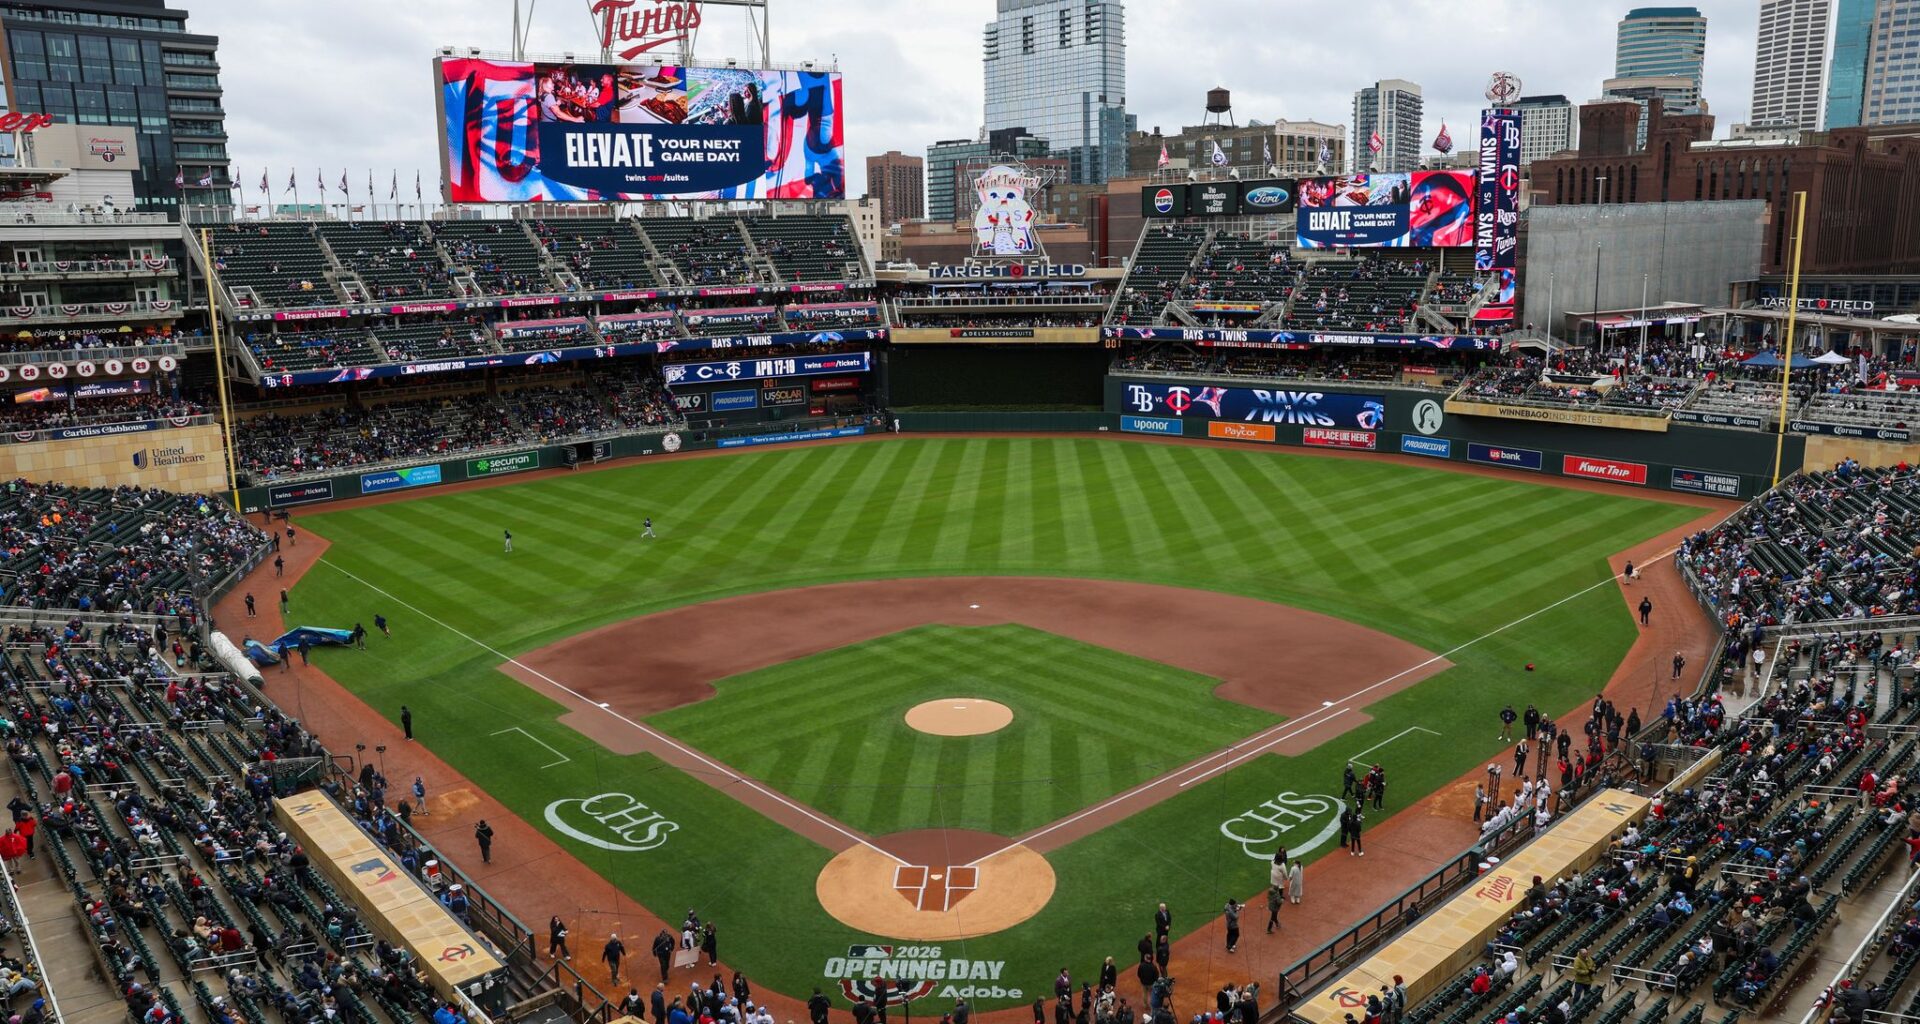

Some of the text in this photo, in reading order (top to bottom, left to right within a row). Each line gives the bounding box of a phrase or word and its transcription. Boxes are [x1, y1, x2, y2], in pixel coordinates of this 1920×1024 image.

[593, 0, 701, 48] Twins
[566, 132, 654, 168] ELEVATE
[658, 139, 741, 149] YOUR NEXT
[662, 152, 740, 162] GAME DAY!
[1480, 138, 1496, 184] TWINS
[625, 174, 689, 182] twins.com/suites
[1003, 174, 1038, 188] Twins!
[1254, 190, 1280, 203] Ford
[1309, 212, 1350, 231] ELEVATE
[1478, 213, 1494, 248] RAYS
[1495, 236, 1516, 252] Twins
[929, 264, 1086, 278] TARGET FIELD
[1831, 300, 1873, 310] FIELD
[283, 310, 341, 320] Treasure Island
[34, 329, 65, 338] Surfside
[1183, 330, 1203, 340] RAYS
[1220, 330, 1248, 341] TWINS
[1323, 335, 1348, 343] OPENING
[1348, 336, 1359, 344] DAY
[1360, 336, 1374, 344] 2026
[712, 338, 732, 348] RAYS
[747, 336, 772, 346] TWINS
[81, 365, 91, 373] 14
[165, 360, 170, 368] 3
[416, 363, 441, 373] OPENING
[441, 363, 451, 371] DAY
[452, 361, 465, 369] 2026
[755, 361, 773, 376] APR
[804, 360, 860, 369] twins.com/tickets
[52, 367, 65, 375] 34
[674, 396, 701, 408] OX 9
[1252, 390, 1324, 407] RAYS
[1245, 407, 1335, 426] TWINS
[1499, 408, 1602, 424] WINNEBAGO INDUSTRIES
[1673, 411, 1697, 420] Corona
[1702, 414, 1727, 423] Corona
[1134, 420, 1168, 431] uponor
[1733, 417, 1758, 427] Corona
[1792, 421, 1820, 432] Corona
[63, 423, 148, 438] Carbliss Clubhouse
[1224, 427, 1258, 437] Paycor
[1834, 425, 1862, 435] Corona
[1877, 429, 1907, 440] Corona
[1318, 431, 1339, 441] PLACE
[1351, 433, 1369, 442] HERE
[152, 446, 184, 458] United
[1404, 440, 1448, 452] PROGRESSIVE
[153, 454, 205, 466] Healthcare
[490, 454, 530, 468] securian
[491, 464, 519, 473] FINANCIAL
[373, 477, 400, 486] PENTAIR
[1704, 475, 1737, 487] CHANGING
[275, 486, 327, 500] twins.com/tickets
[1704, 483, 1736, 494] THE GAME
[581, 793, 679, 843] CHS
[1220, 792, 1330, 843] CHS
[896, 946, 942, 959] 2026
[824, 958, 1005, 980] OPENING DAY
[938, 985, 1023, 999] Adobe
